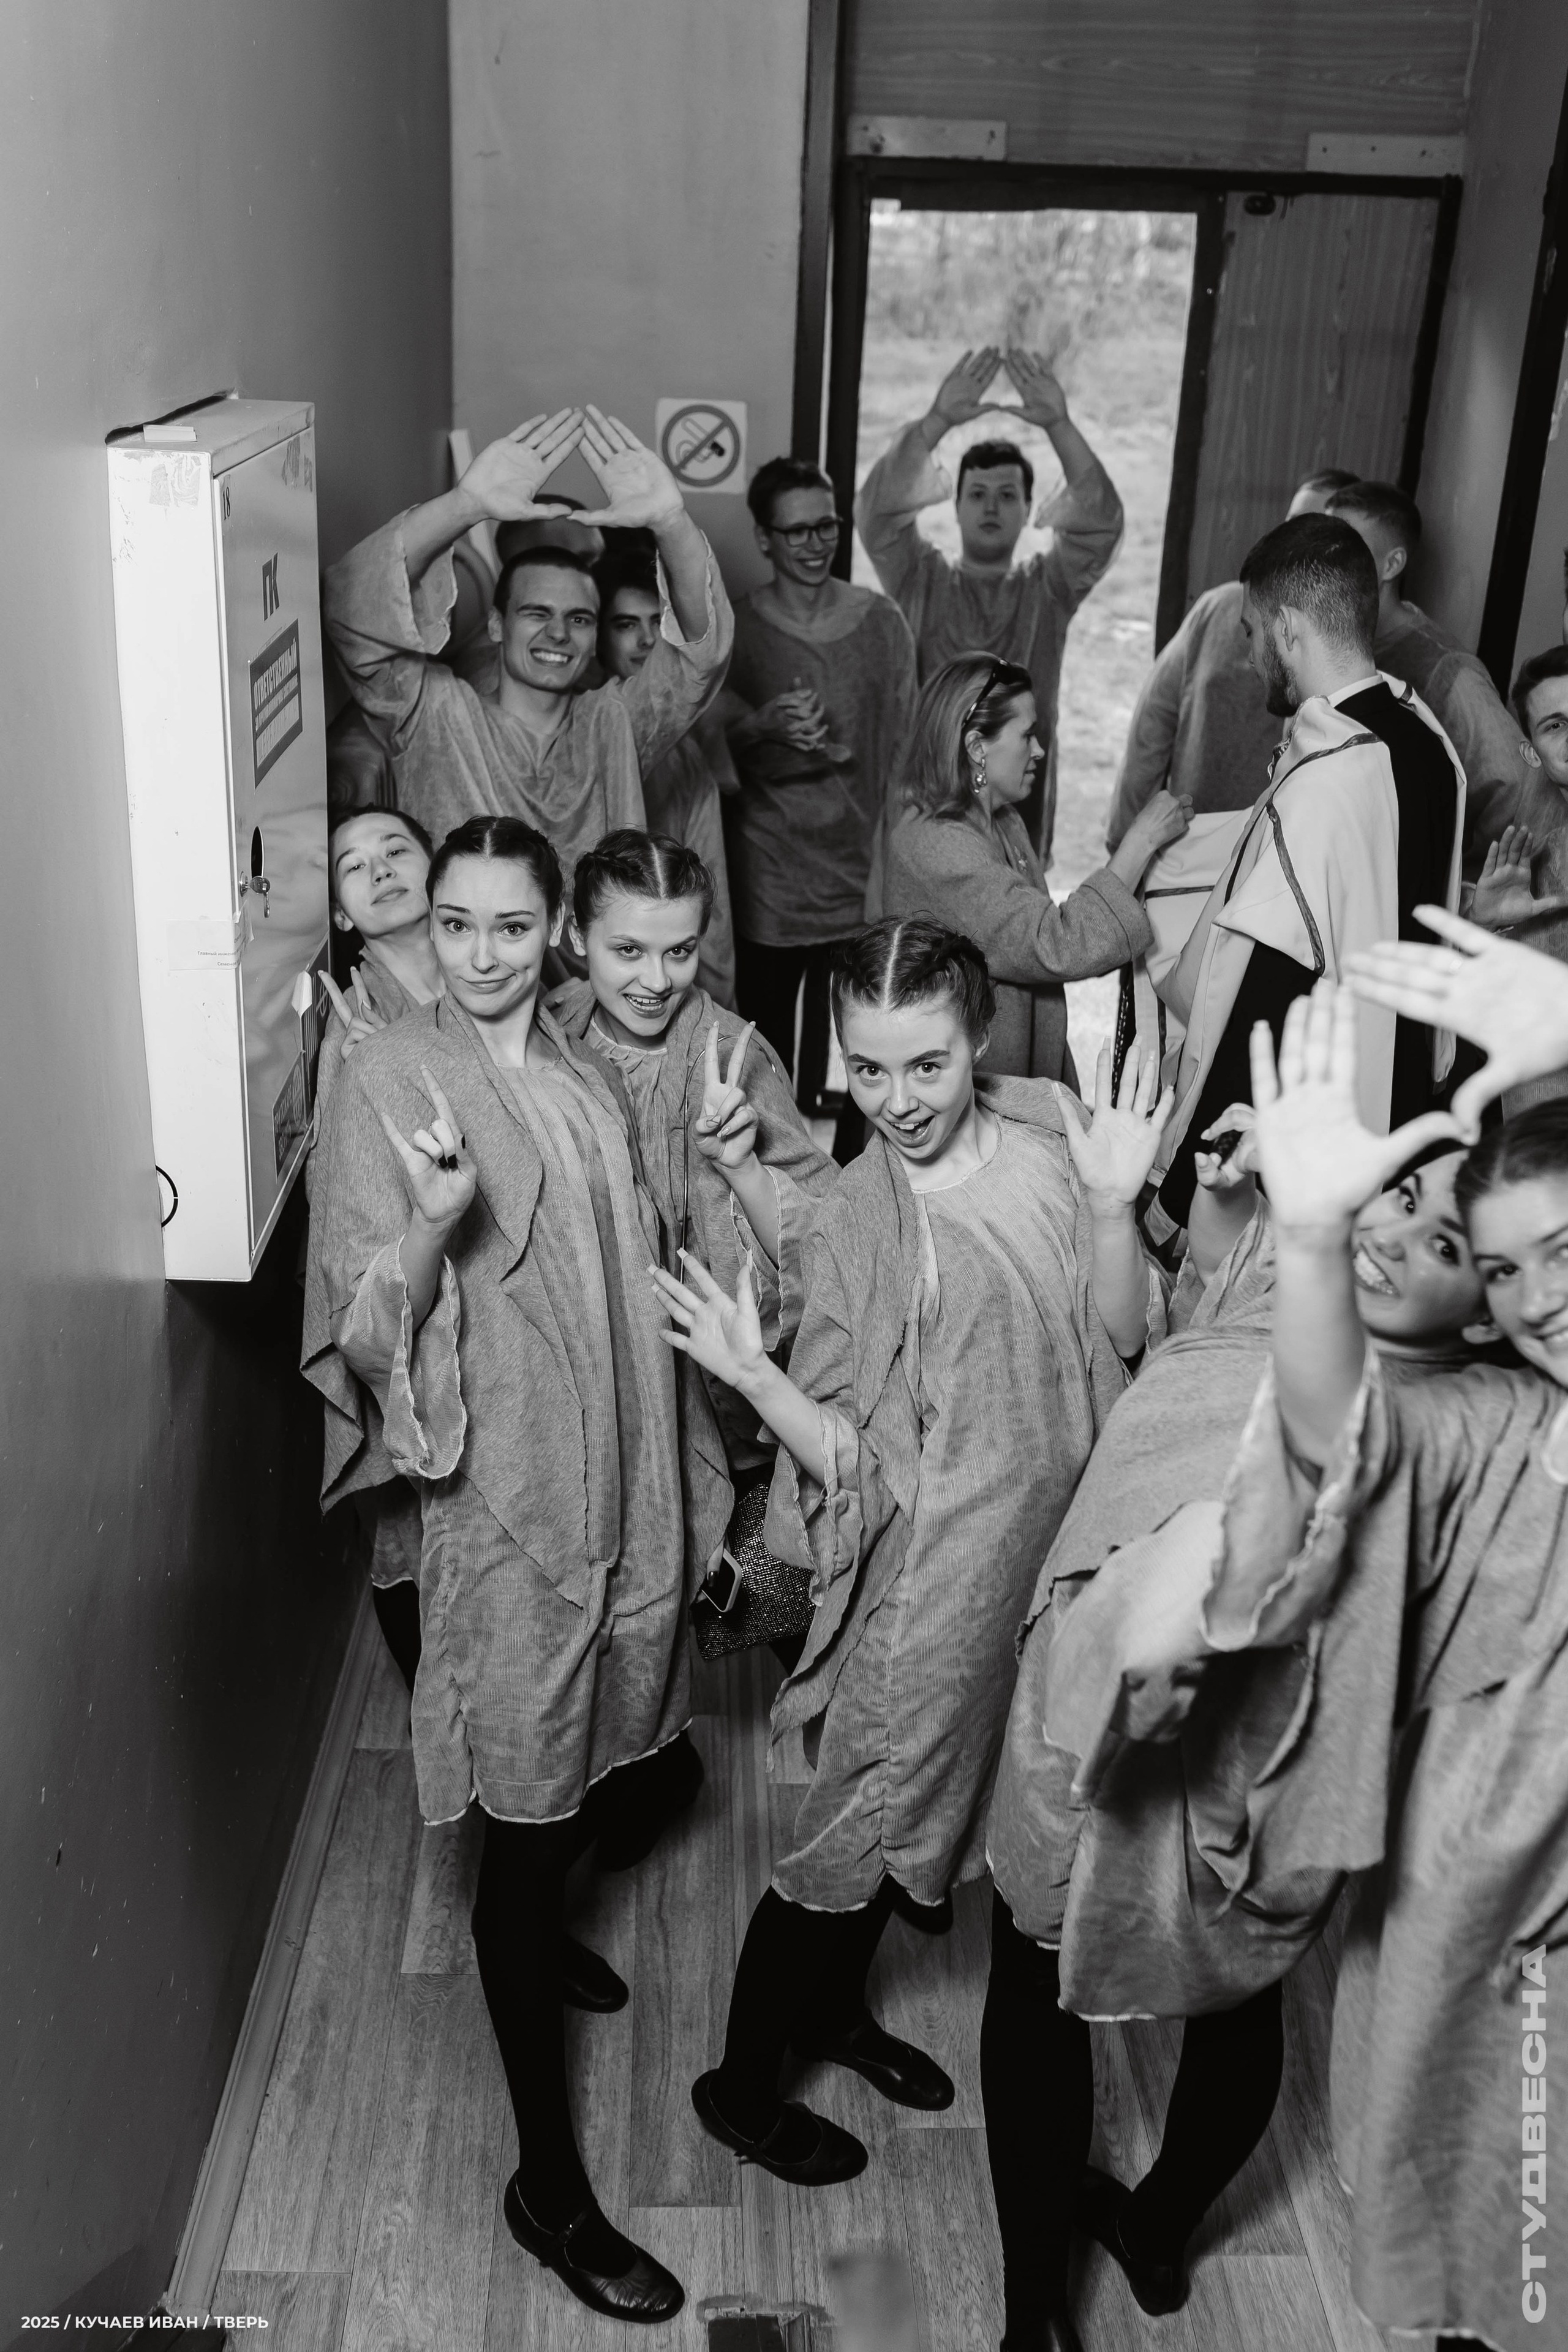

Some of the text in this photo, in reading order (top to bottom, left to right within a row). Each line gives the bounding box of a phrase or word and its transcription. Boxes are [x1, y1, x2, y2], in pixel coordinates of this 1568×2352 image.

[223, 487, 230, 520] 18
[262, 552, 279, 621] ПК
[254, 637, 298, 710] ОТВЕТСТВЕННЫЙ
